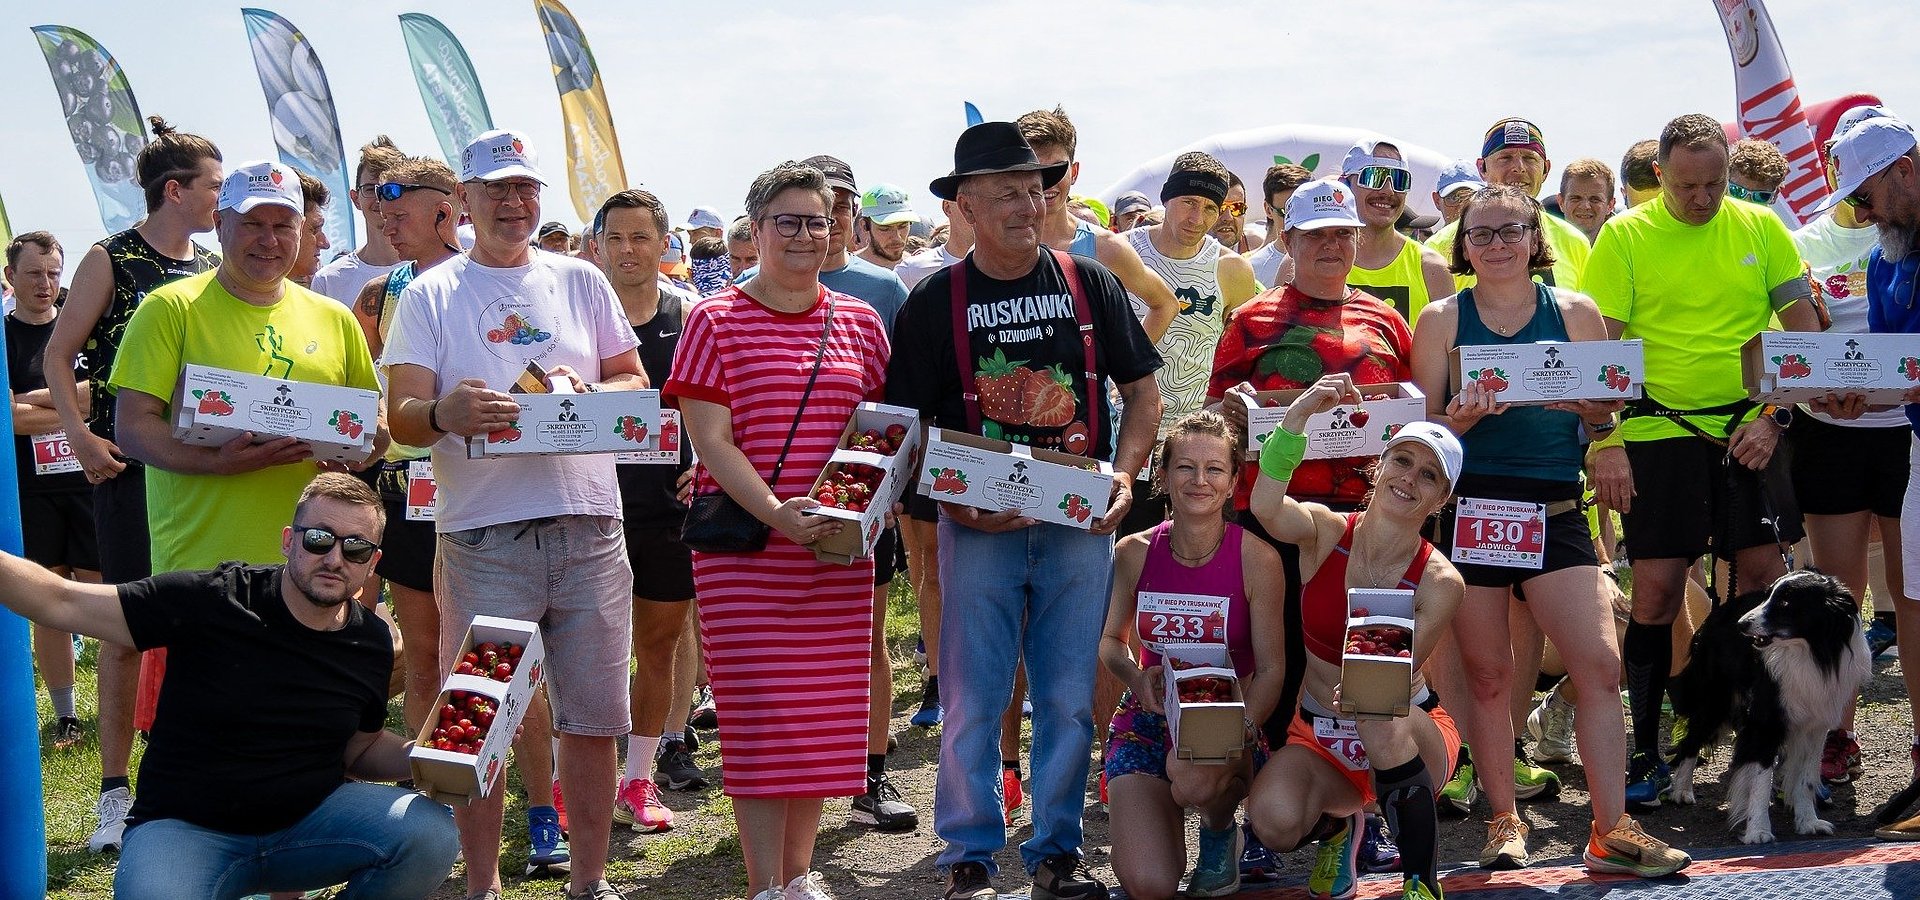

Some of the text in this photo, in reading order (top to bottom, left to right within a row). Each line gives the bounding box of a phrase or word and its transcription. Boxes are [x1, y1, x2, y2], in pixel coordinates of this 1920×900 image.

[492, 145, 512, 154] BIEG
[248, 175, 269, 183] BIEG
[999, 325, 1043, 343] DZWONIĄ
[260, 405, 301, 416] SKRZYPCZYK
[1318, 430, 1357, 438] SKRZYPCZYK
[45, 441, 76, 457] 16
[995, 481, 1035, 494] SKRZYPCZYK
[1506, 506, 1538, 514] TRUSKAWK
[1470, 519, 1524, 544] 130
[1475, 542, 1517, 551] JADWIGA
[1151, 614, 1205, 639] 233
